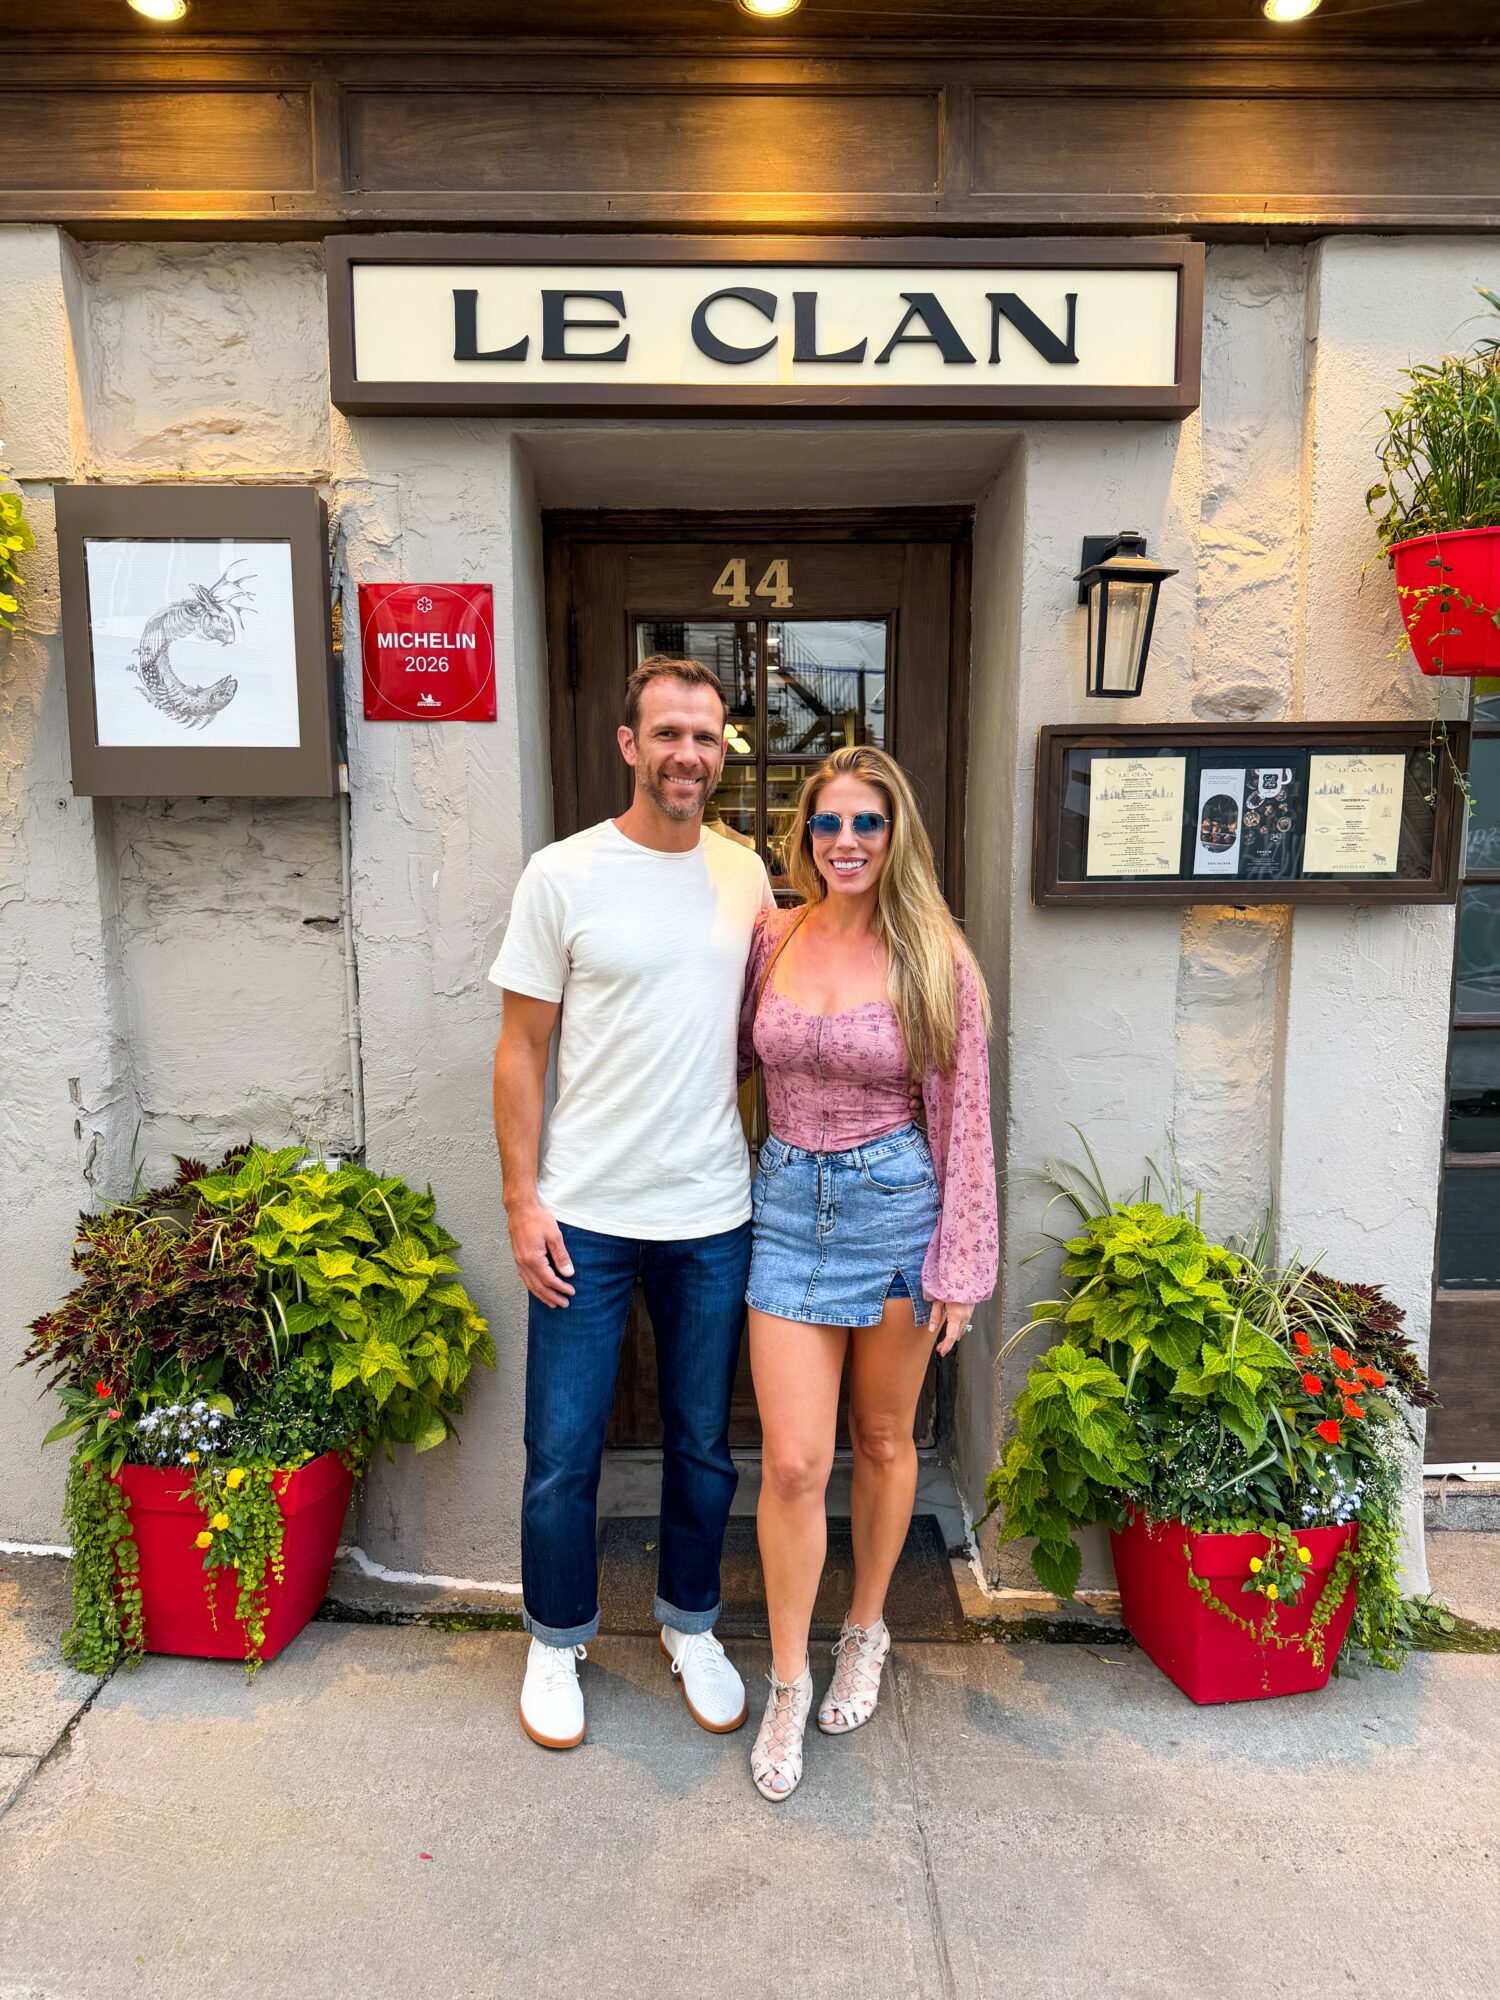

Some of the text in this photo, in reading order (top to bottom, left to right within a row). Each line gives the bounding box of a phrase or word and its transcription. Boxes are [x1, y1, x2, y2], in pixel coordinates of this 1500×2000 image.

[453, 286, 1080, 366] LE CLAN
[711, 558, 794, 608] 44
[377, 632, 476, 649] MICHELIN
[404, 656, 449, 672] 2026
